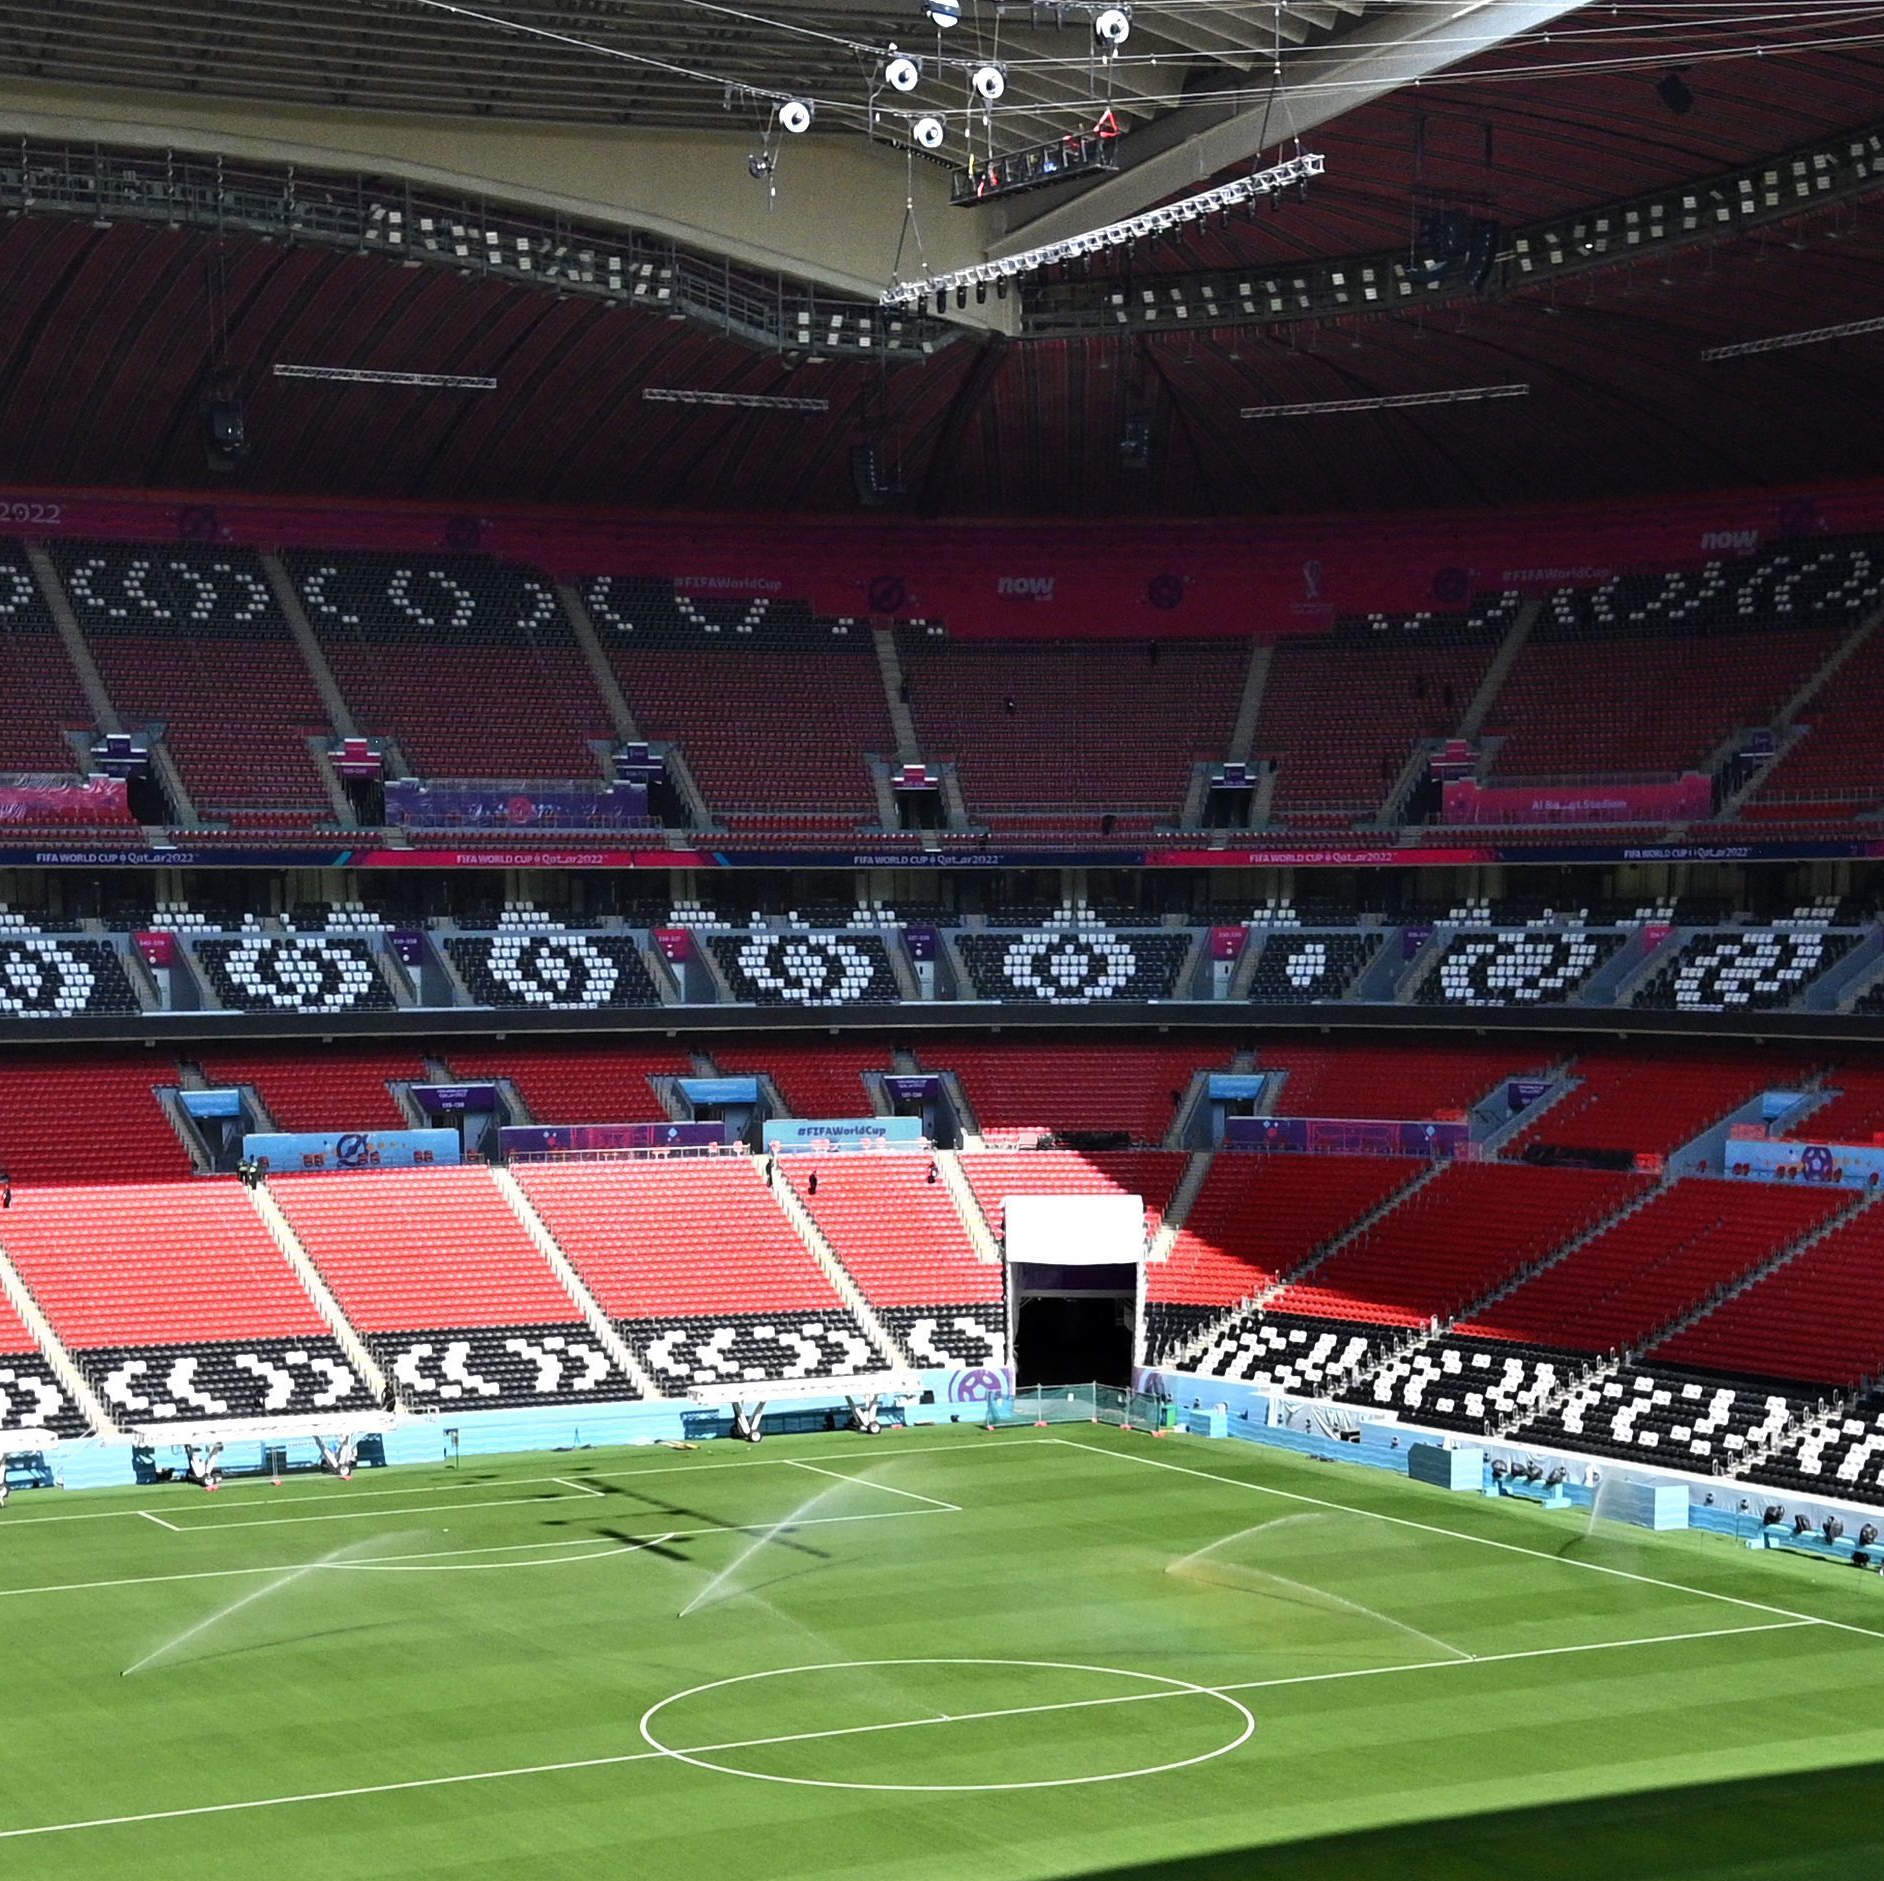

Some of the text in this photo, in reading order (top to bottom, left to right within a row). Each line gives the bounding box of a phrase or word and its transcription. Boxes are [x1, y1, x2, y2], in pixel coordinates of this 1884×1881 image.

[1700, 530, 1759, 550] now
[997, 576, 1055, 595] now
[36, 853, 59, 864] FIFA
[58, 853, 97, 864] WORLD
[97, 853, 118, 864] CUP
[1249, 854, 1270, 864] FIFA
[1269, 853, 1305, 864] WORLD
[1305, 853, 1323, 863] CUP
[1623, 849, 1644, 860] FIFA
[1643, 848, 1671, 859] WORLD
[1671, 848, 1688, 858] CUP
[456, 855, 478, 865] FIFA
[477, 855, 514, 865] WORLD
[514, 855, 533, 865] CUP
[854, 856, 875, 865] FIFA
[873, 856, 909, 865] WORLD
[909, 856, 928, 865] CUP
[797, 1125, 887, 1138] #FIFAWorldCup
